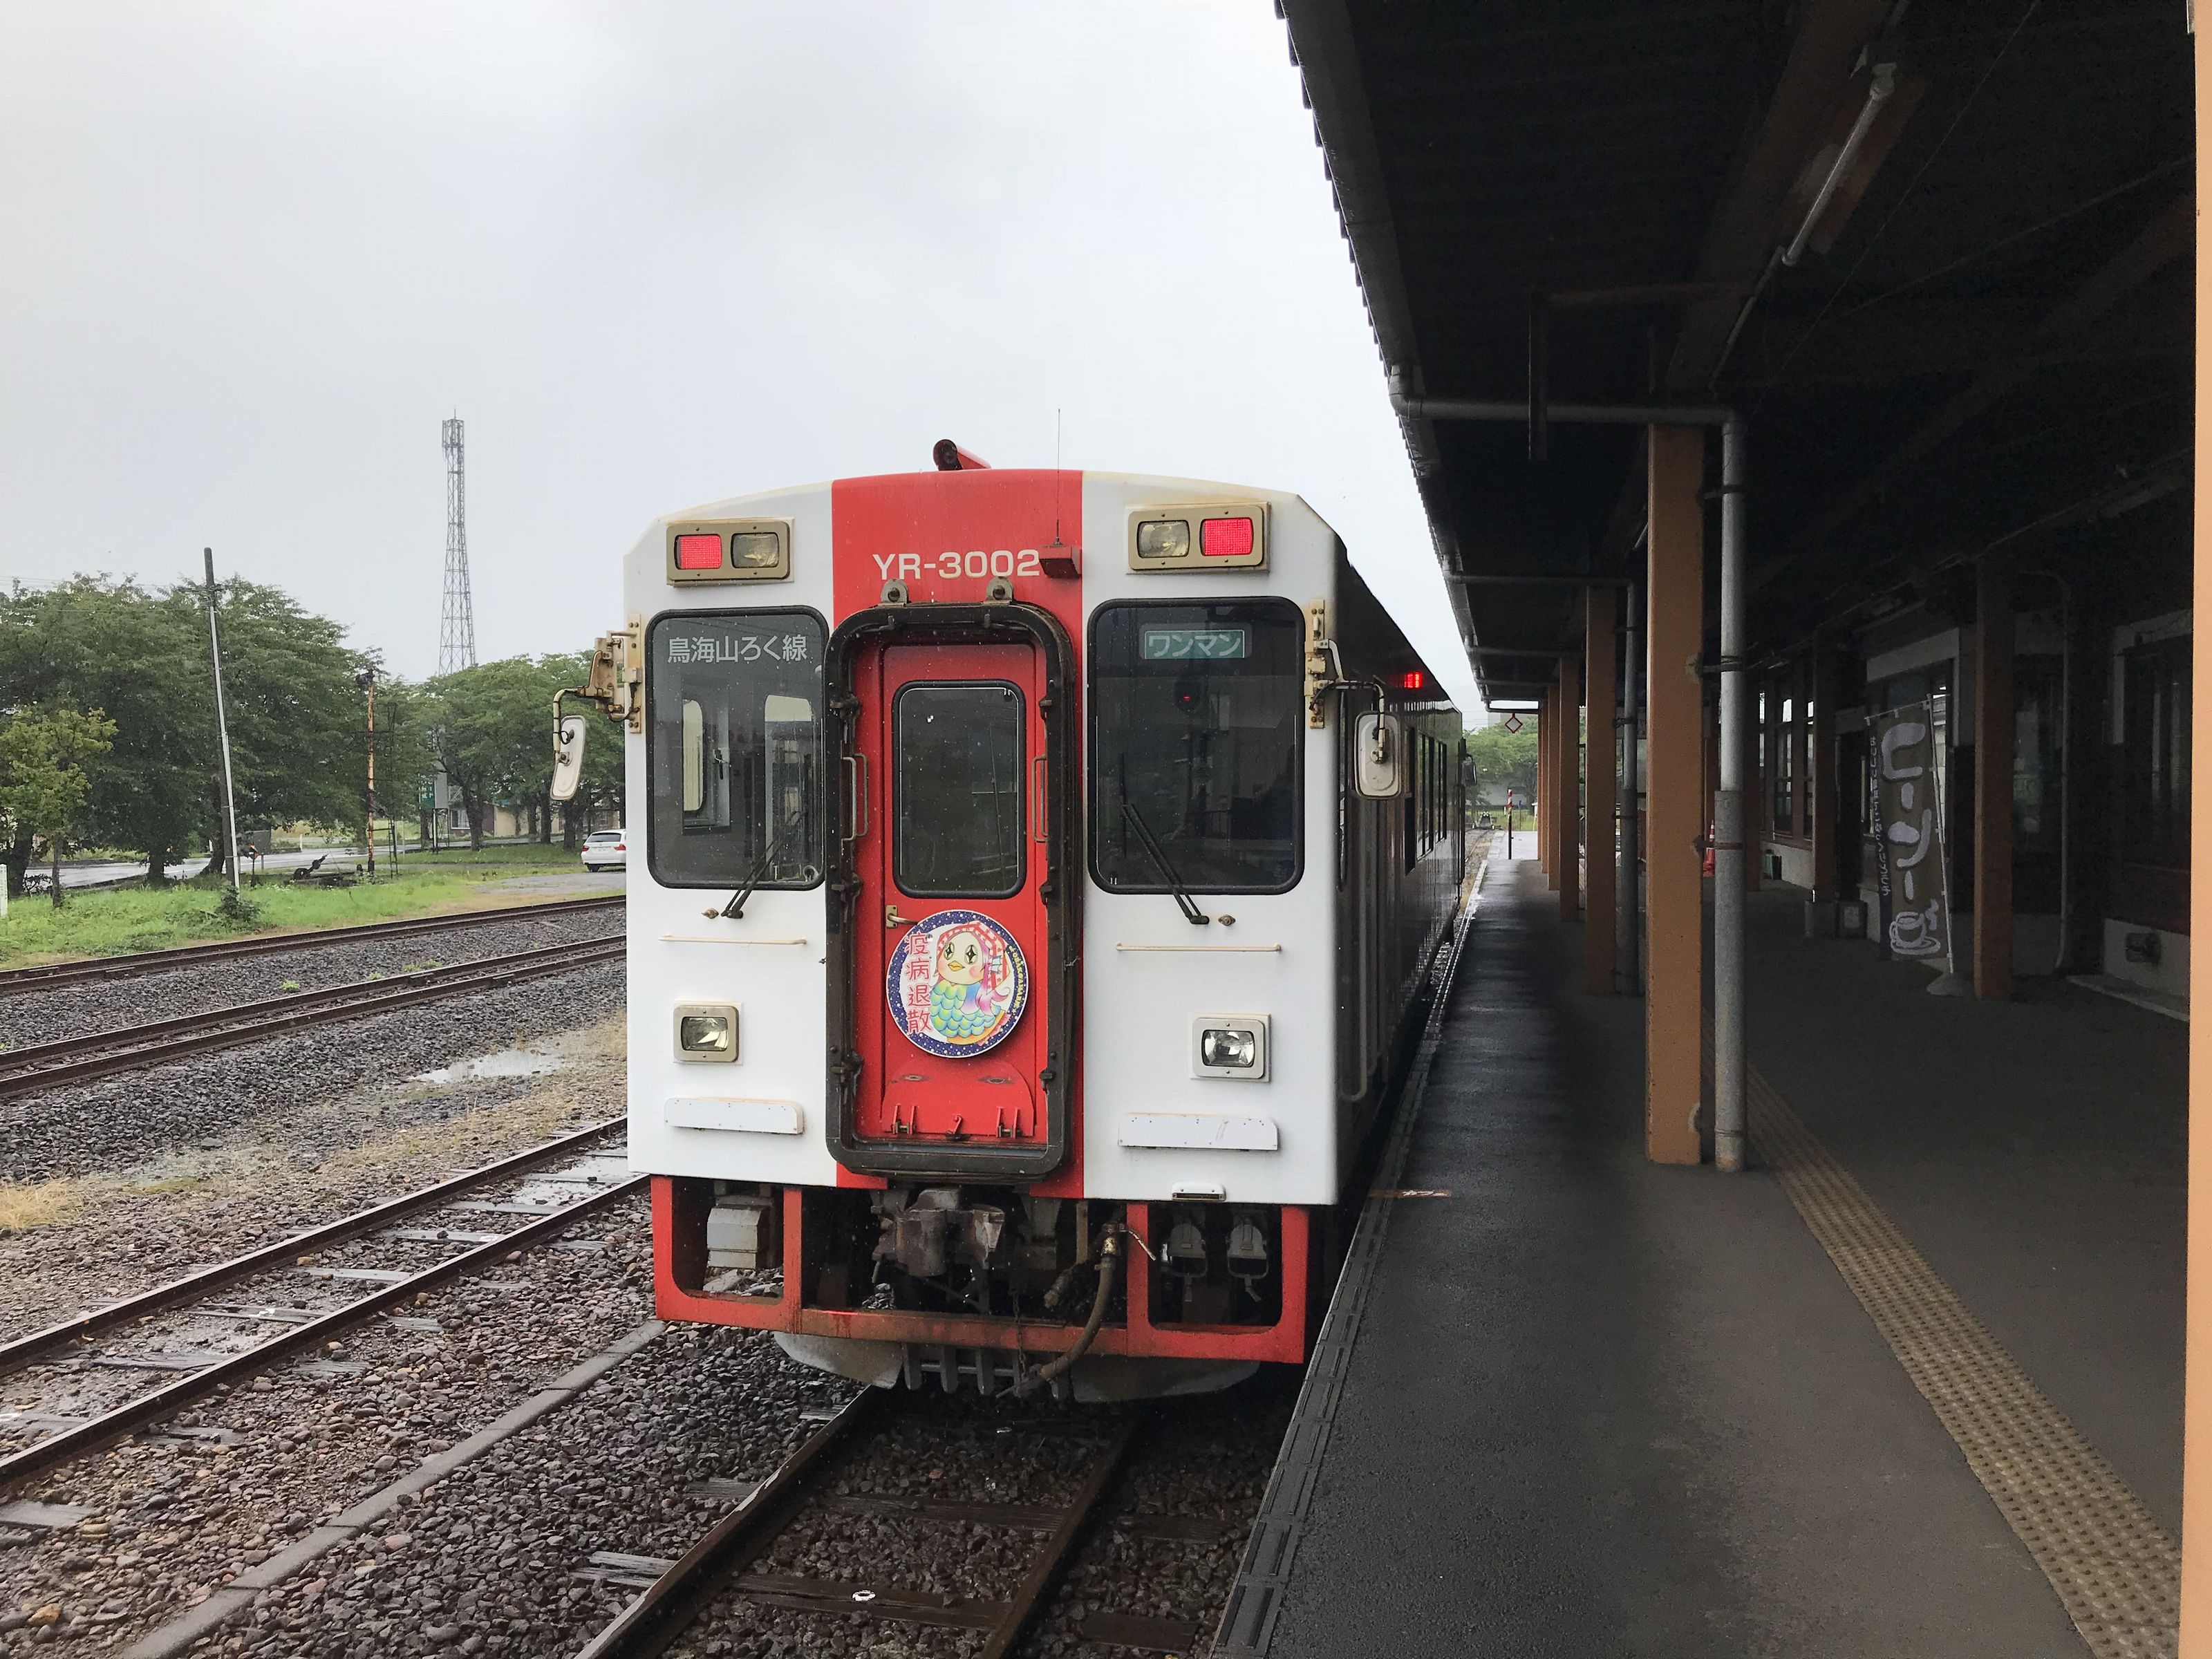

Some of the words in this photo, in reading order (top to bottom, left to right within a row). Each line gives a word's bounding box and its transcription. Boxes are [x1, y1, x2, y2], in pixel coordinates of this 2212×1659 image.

[872, 549, 1040, 580] YR-3002
[668, 634, 808, 664] 鳥海山ろく線
[1148, 634, 1241, 657] ワンマン
[904, 932, 932, 1033] 疫病退散
